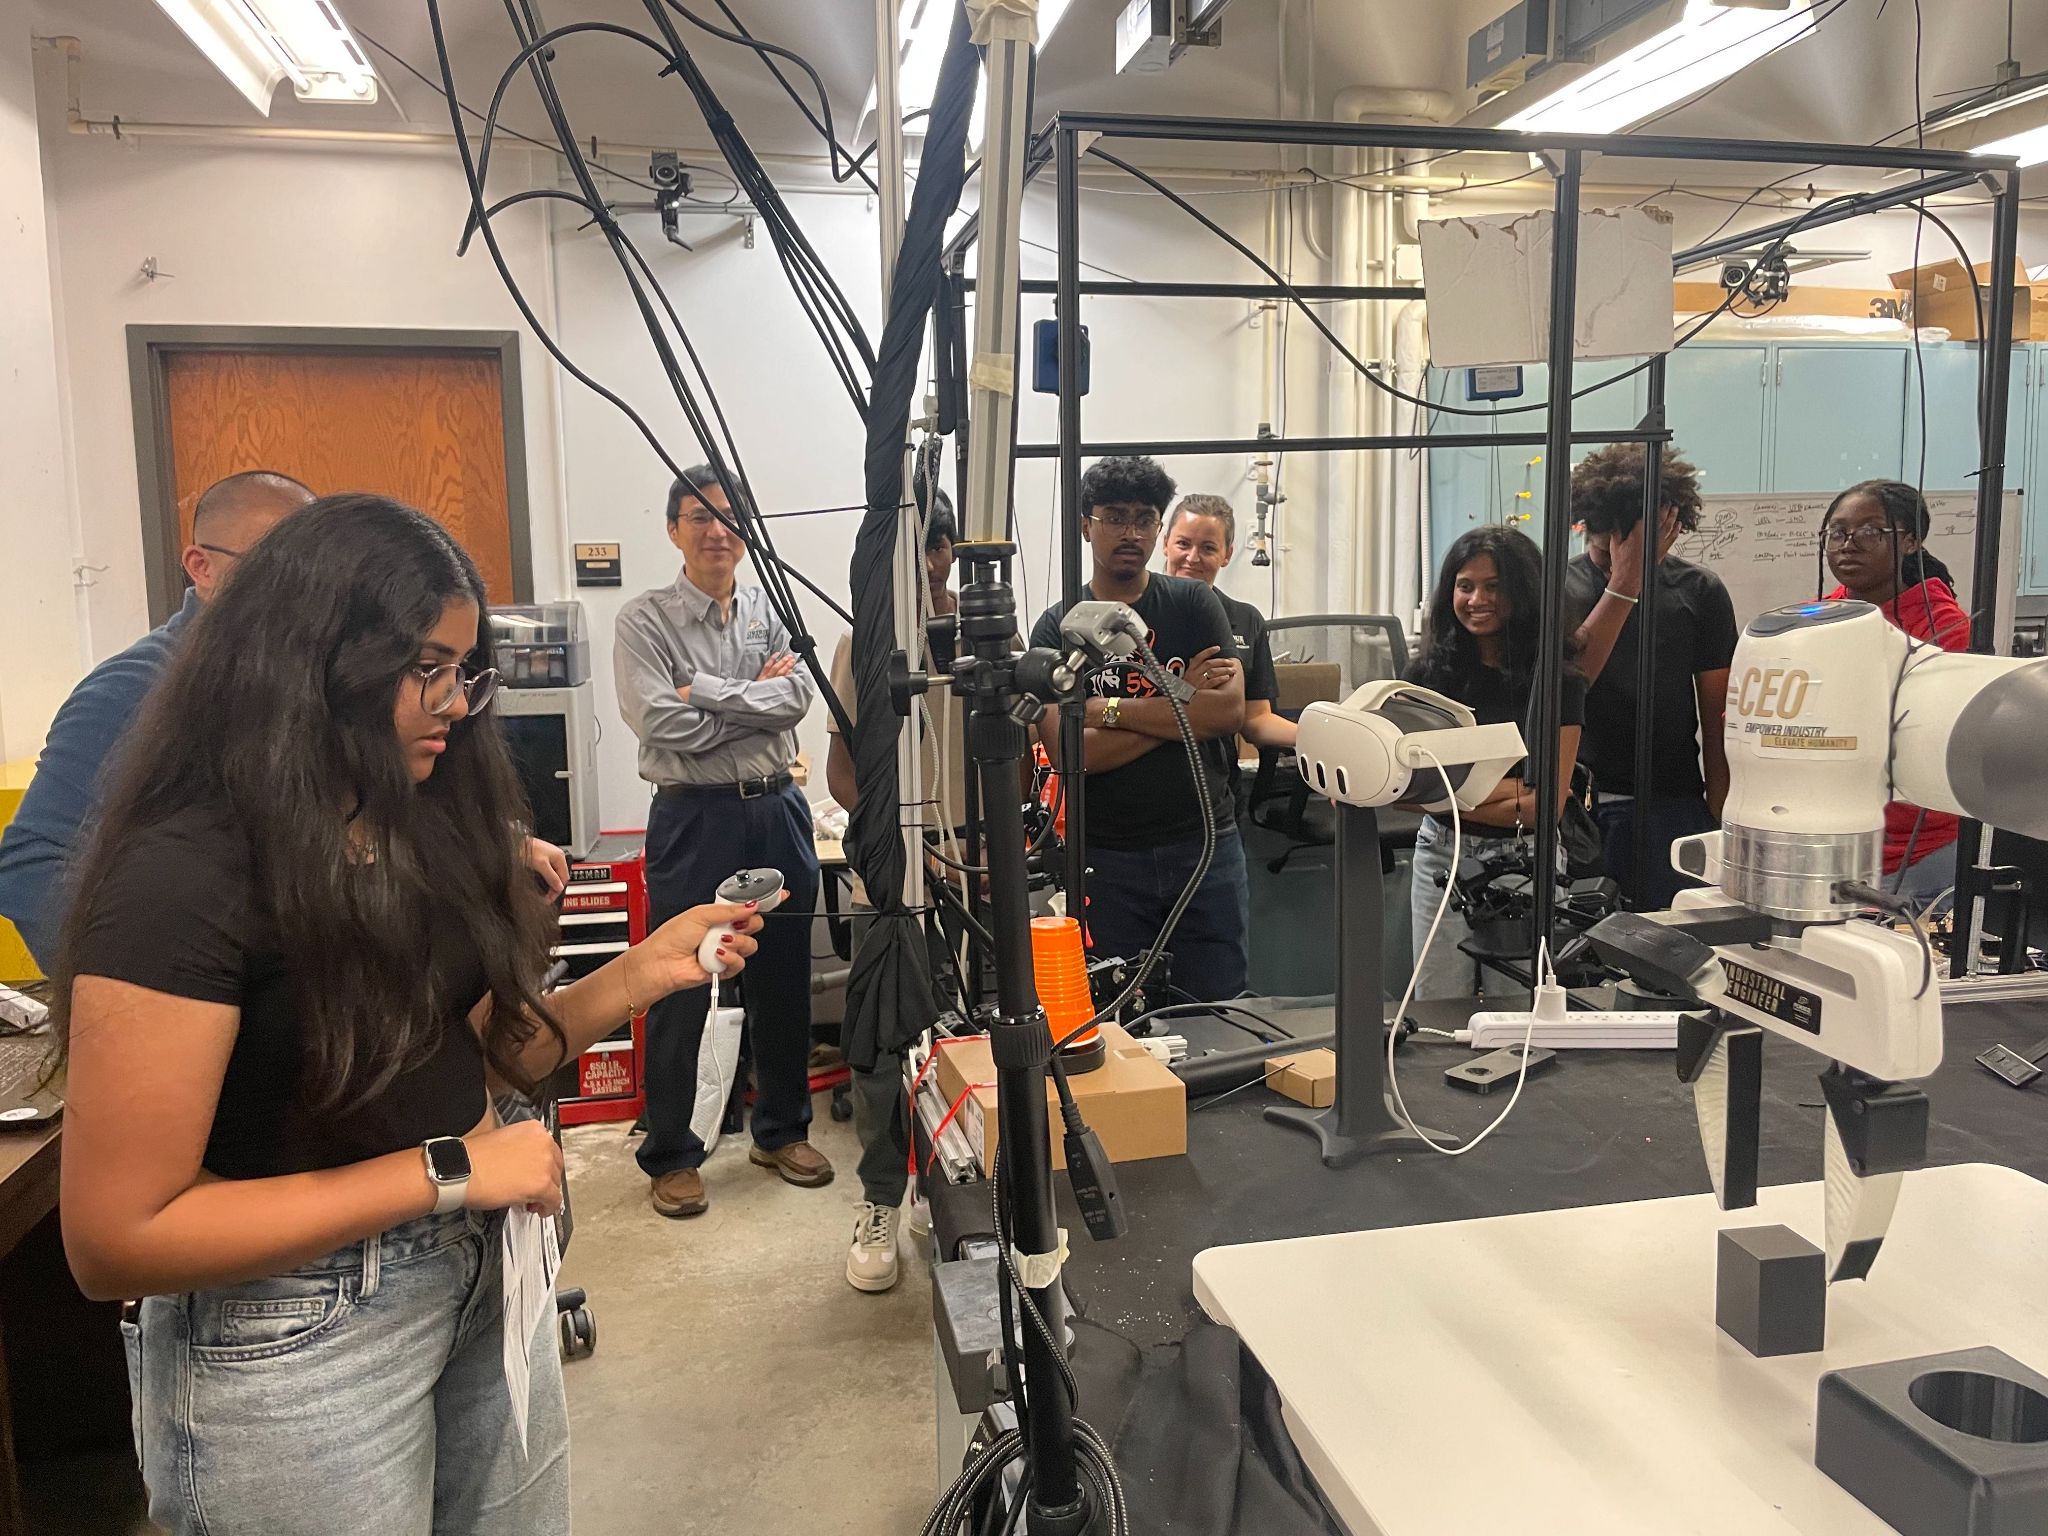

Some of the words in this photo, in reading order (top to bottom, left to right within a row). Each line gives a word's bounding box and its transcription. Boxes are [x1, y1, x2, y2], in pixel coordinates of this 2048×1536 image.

[1869, 297, 1909, 320] 3M
[588, 547, 607, 557] 233
[1738, 667, 1809, 719] CEO
[1745, 722, 1782, 736] EMPOWER
[1783, 725, 1829, 737] INDUSTRY
[1774, 736, 1806, 748] ELEVATE
[1807, 738, 1849, 748] HUMANITY
[570, 869, 608, 880] TSMAN
[563, 897, 579, 908] ING
[580, 896, 610, 906] SLIDES
[1725, 962, 1786, 1001] INDUSTRIAL
[1727, 980, 1778, 1013] ENGINEER
[590, 1062, 607, 1071] 650
[585, 1067, 627, 1080] CAPACITY
